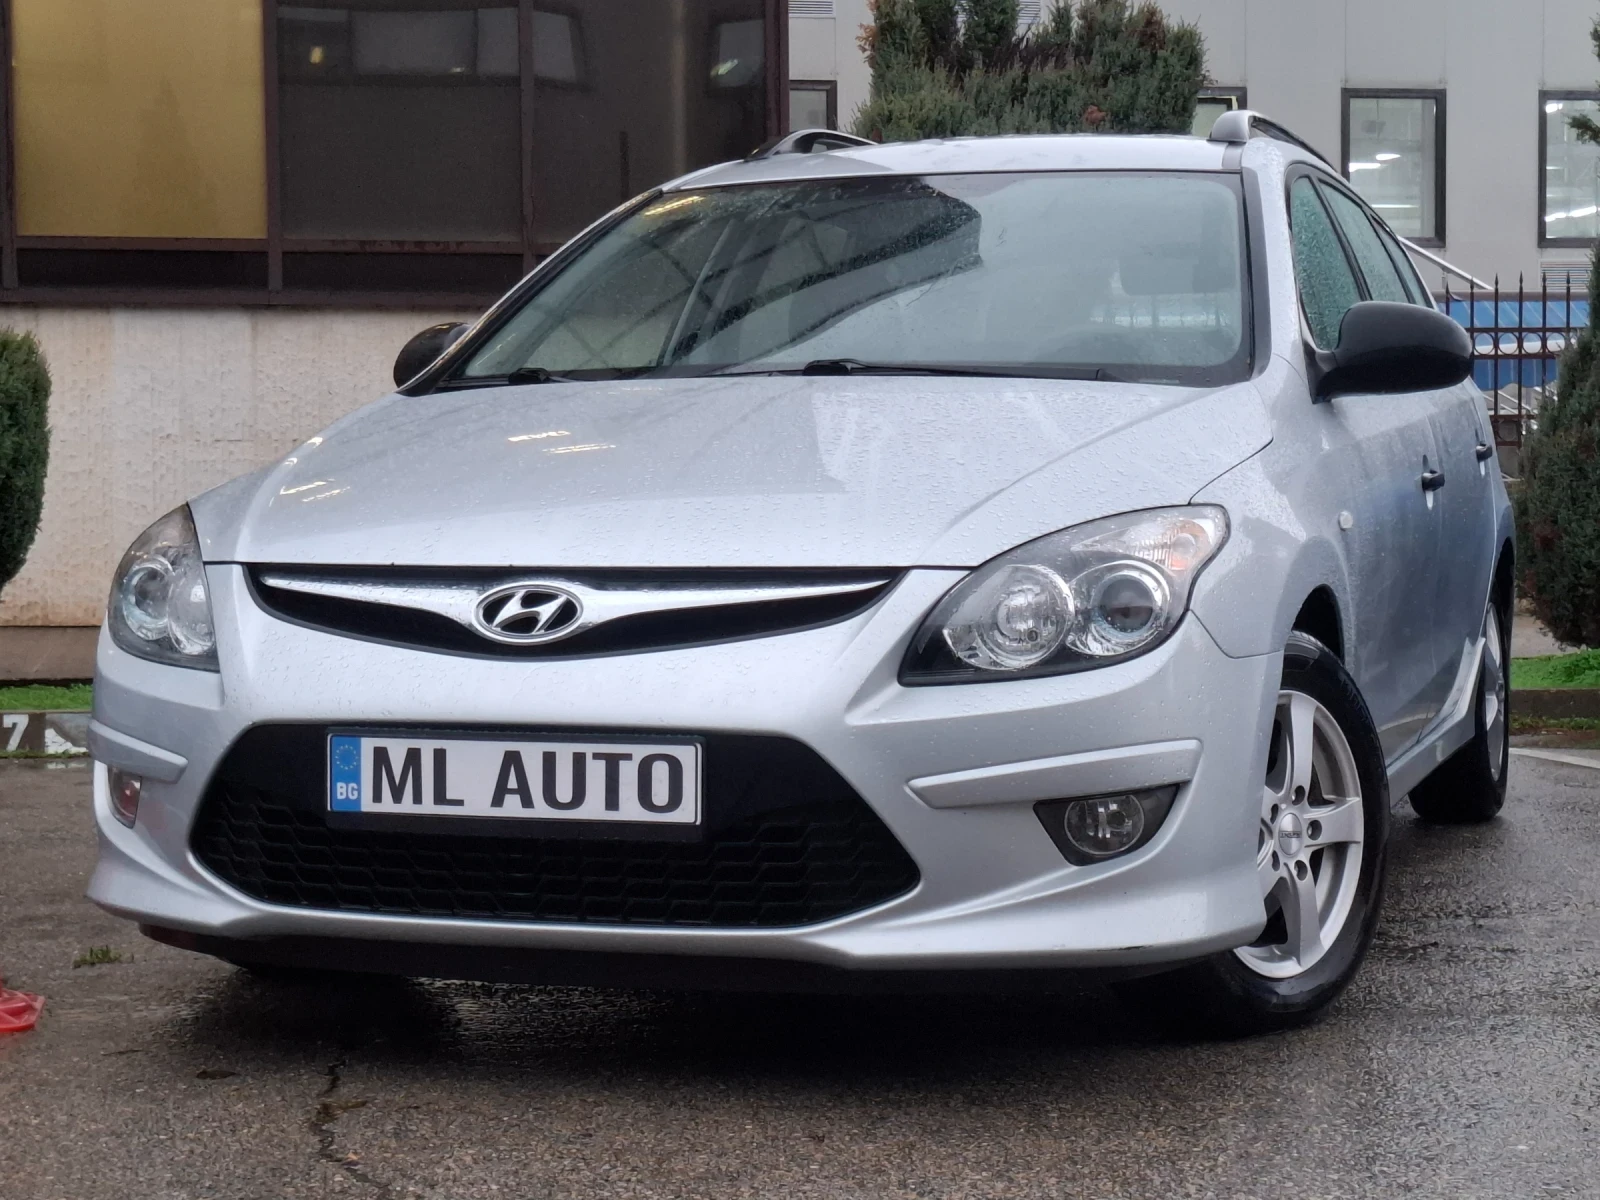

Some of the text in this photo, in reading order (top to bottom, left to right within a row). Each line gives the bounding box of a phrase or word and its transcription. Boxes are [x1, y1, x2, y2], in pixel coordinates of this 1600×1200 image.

[3, 714, 29, 752] 7
[336, 782, 358, 800] BG
[372, 746, 683, 813] ML AUTO
